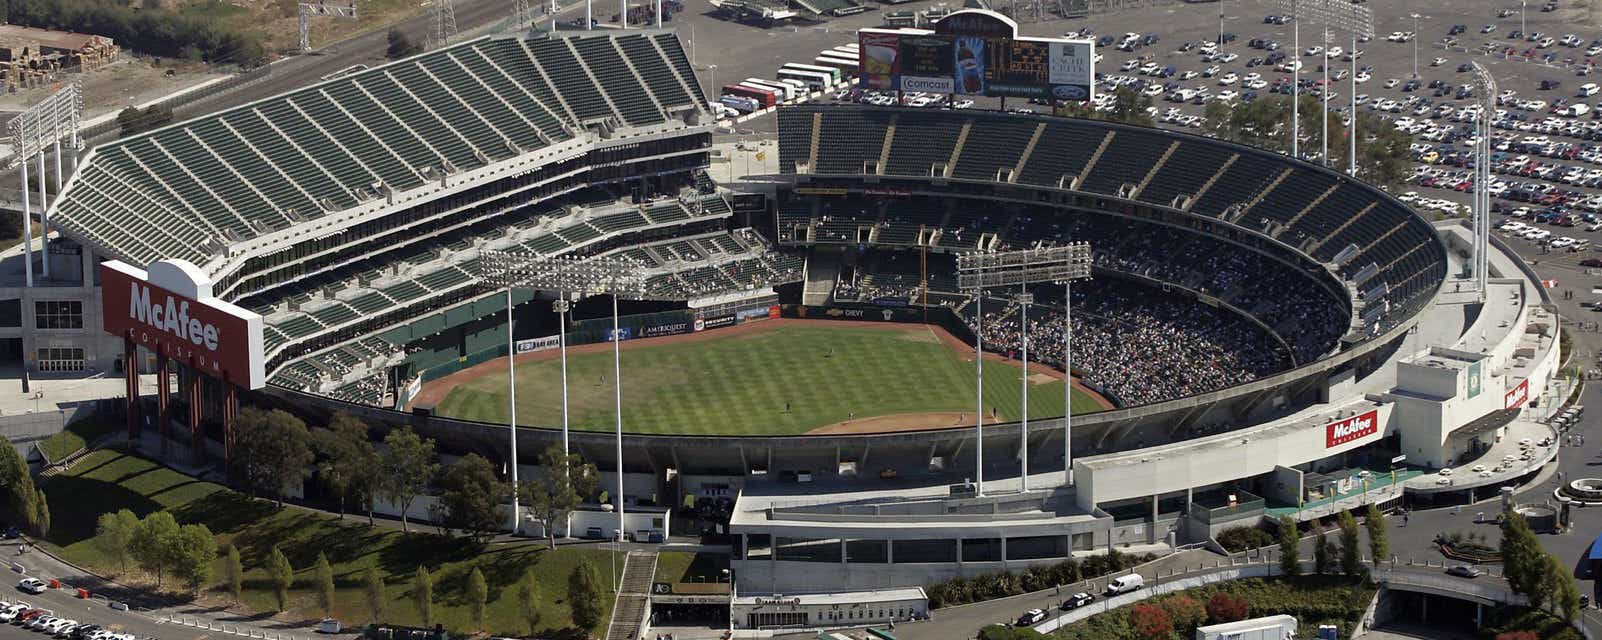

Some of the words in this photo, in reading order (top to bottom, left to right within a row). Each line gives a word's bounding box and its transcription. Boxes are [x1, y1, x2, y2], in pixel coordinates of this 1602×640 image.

[130, 281, 219, 351] McAfee
[130, 327, 219, 370] COLISEUM
[1333, 417, 1372, 439] McAfee
